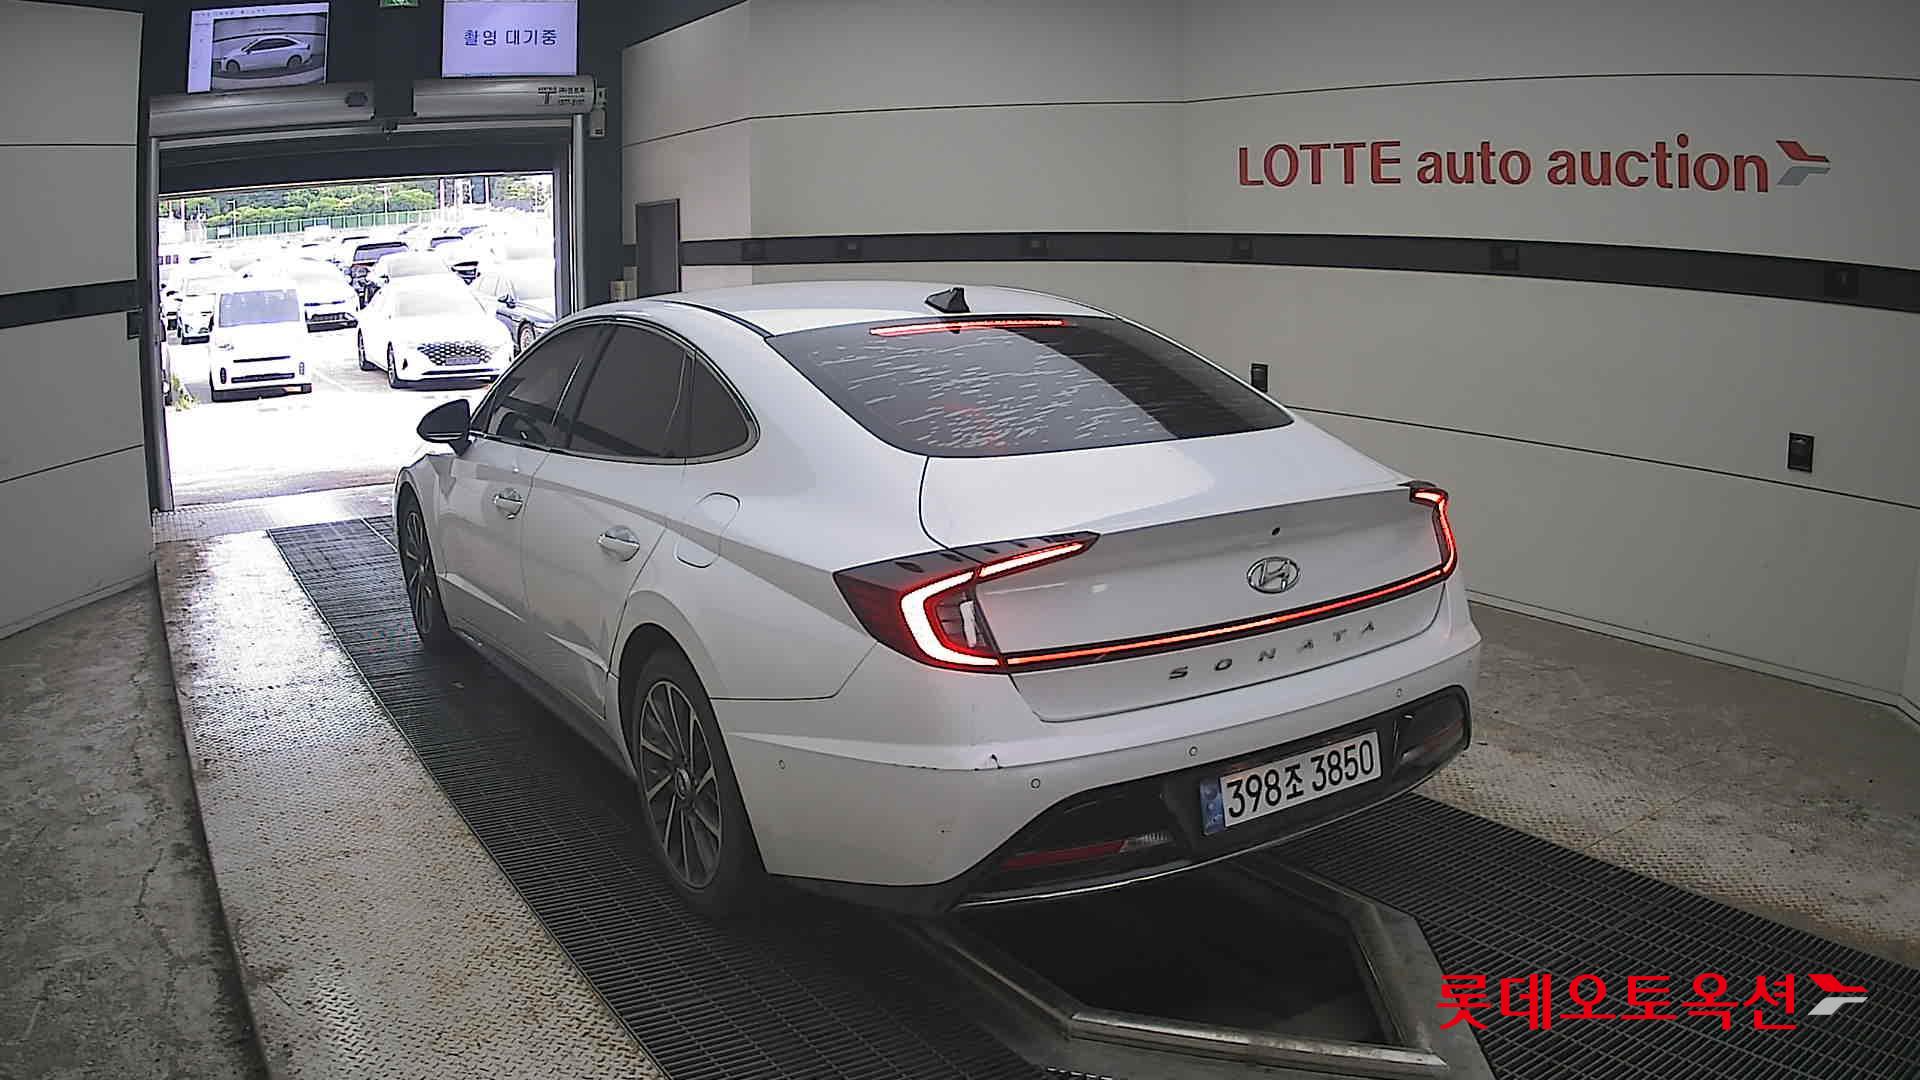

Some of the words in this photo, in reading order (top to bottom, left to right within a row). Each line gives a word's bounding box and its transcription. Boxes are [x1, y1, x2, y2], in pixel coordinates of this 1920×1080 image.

[505, 29, 557, 46] 대기중
[1238, 140, 1401, 188] LOTTE
[1416, 140, 1532, 185] auto
[1547, 132, 1768, 193] auction
[1168, 620, 1376, 681] SONATA
[1226, 763, 1304, 818] 398조
[1311, 739, 1374, 792] 3850
